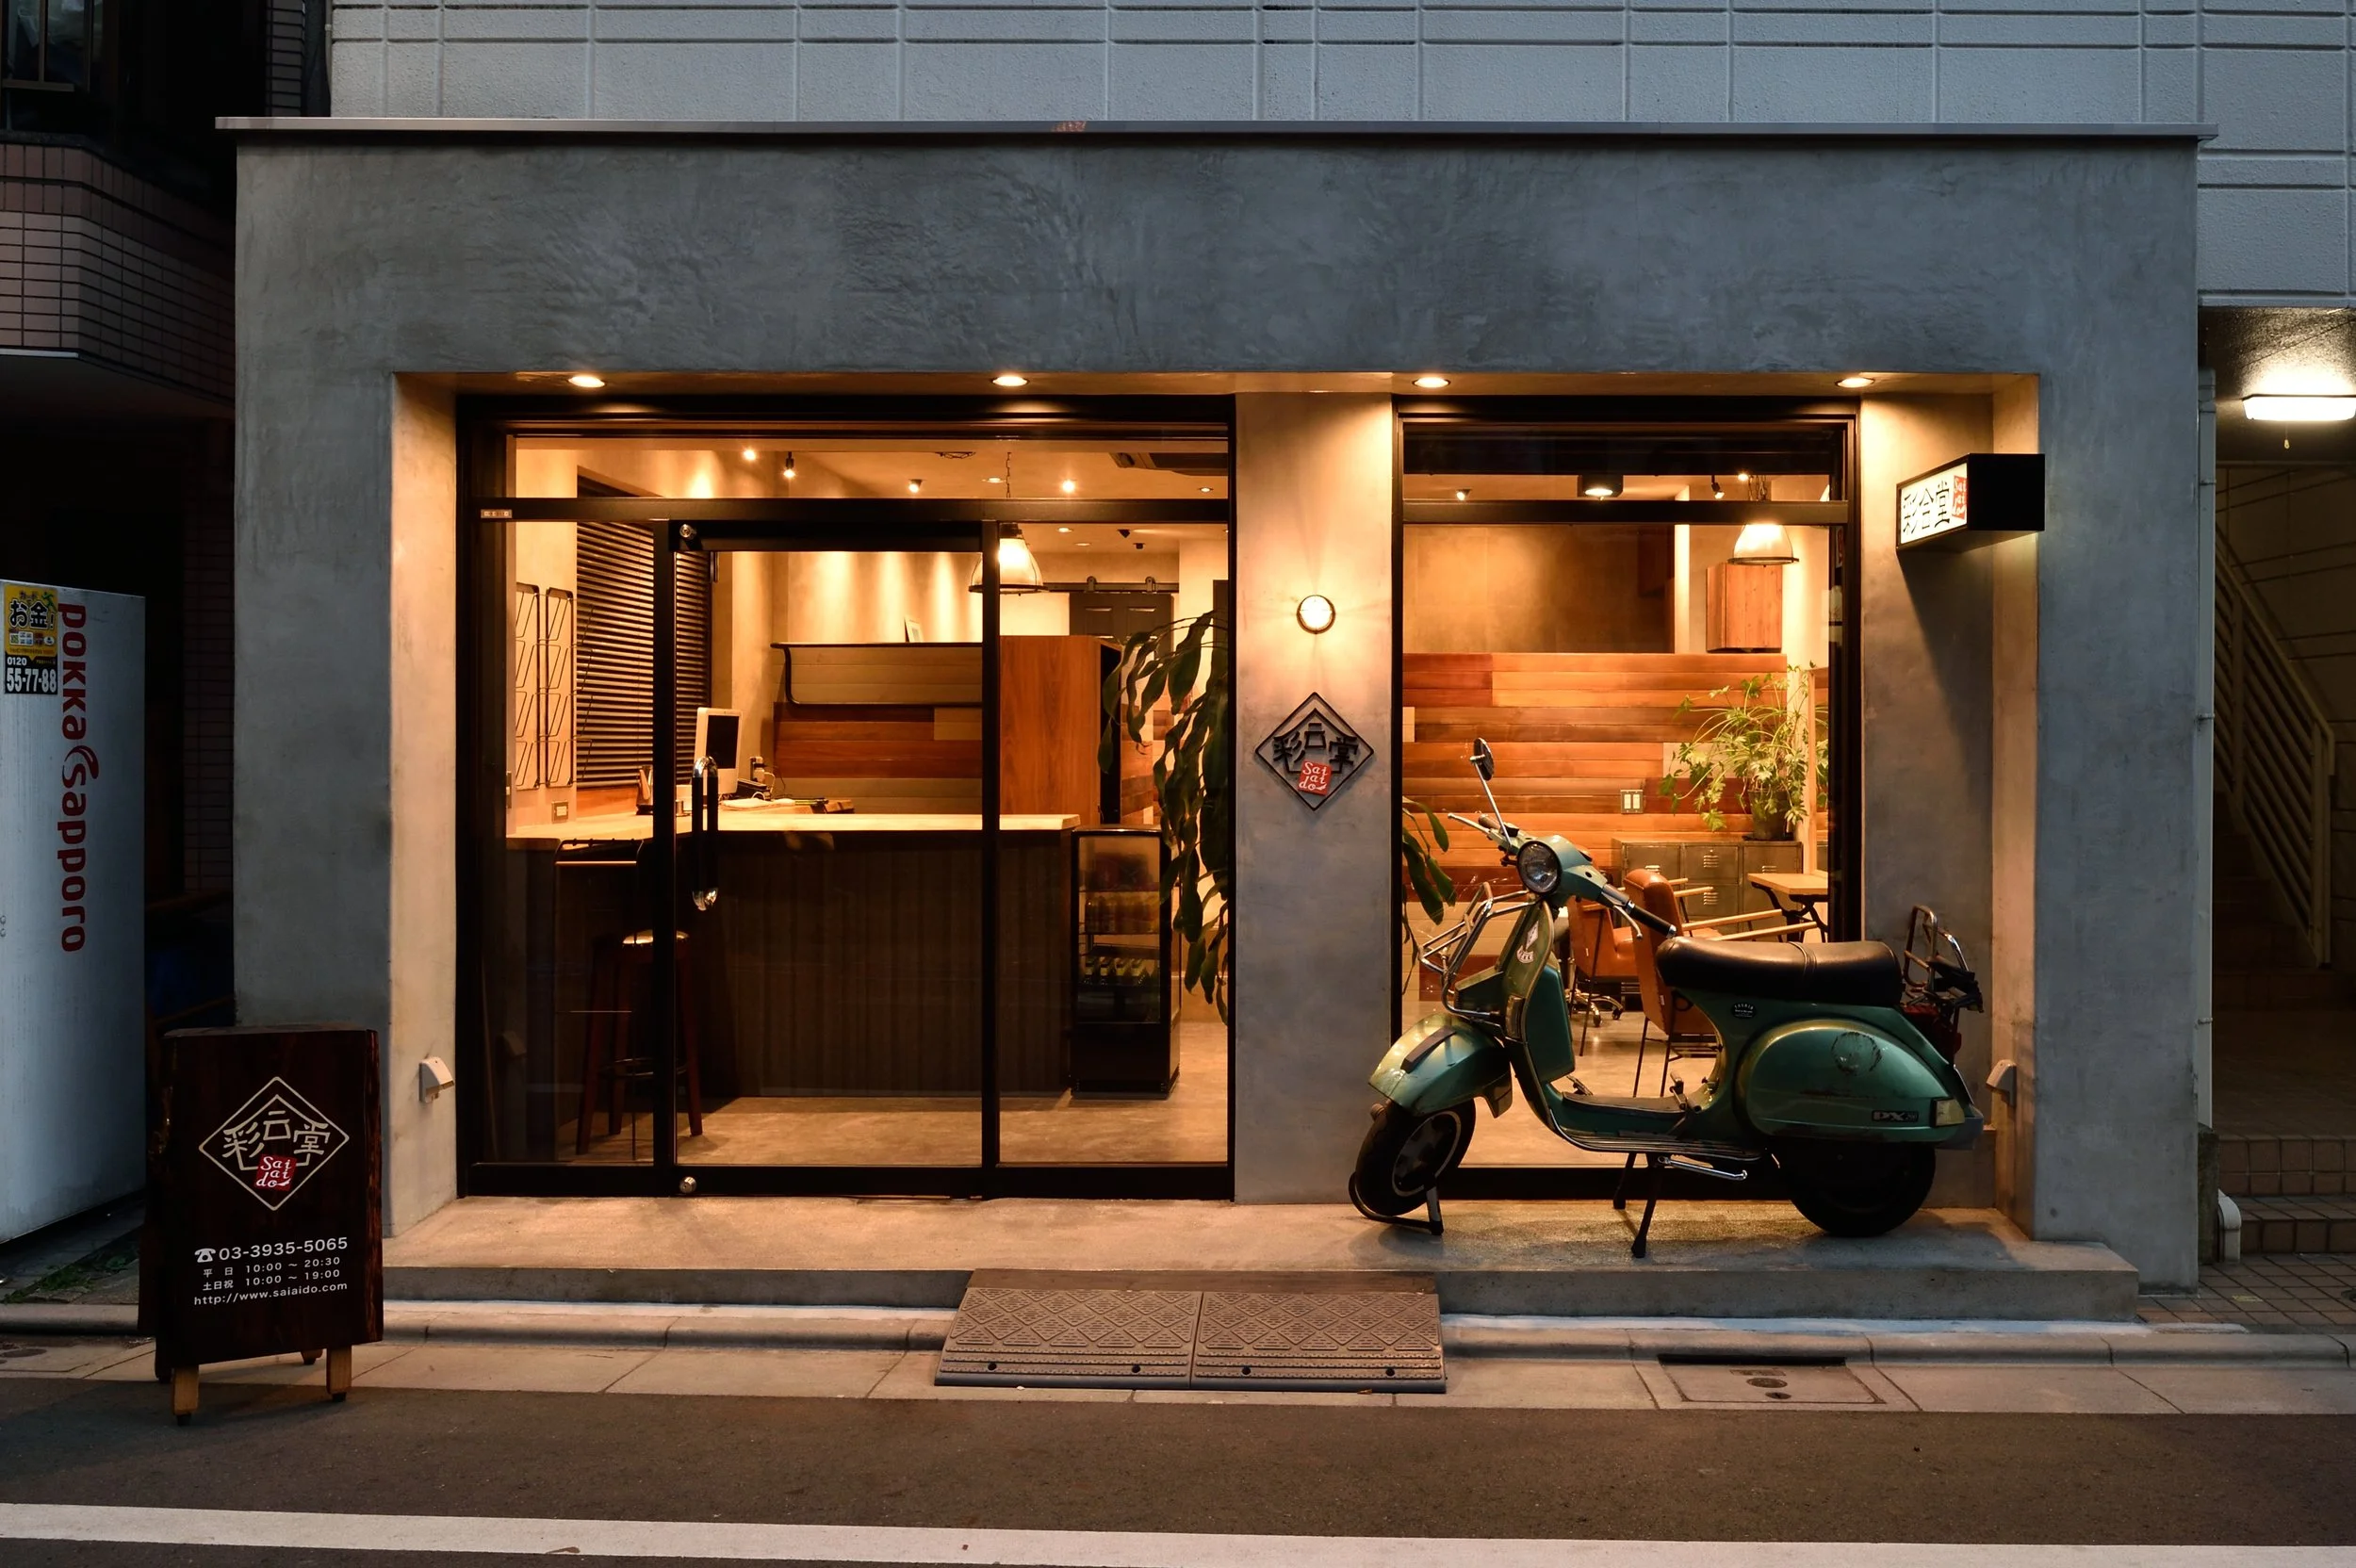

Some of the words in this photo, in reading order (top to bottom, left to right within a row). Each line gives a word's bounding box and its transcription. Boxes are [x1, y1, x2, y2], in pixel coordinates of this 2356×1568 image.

[7, 656, 27, 666] 0120
[57, 603, 87, 740] pokka
[7, 667, 57, 694] 55-77-88
[219, 1236, 348, 1261] 03-3935-5065
[245, 1263, 282, 1273] 10:00
[303, 1257, 340, 1267] 20:30
[203, 1280, 234, 1291] 土日祝
[245, 1275, 282, 1286] 10:00
[304, 1269, 340, 1281] 19:00
[194, 1282, 348, 1305] http://www.saiaido.com
